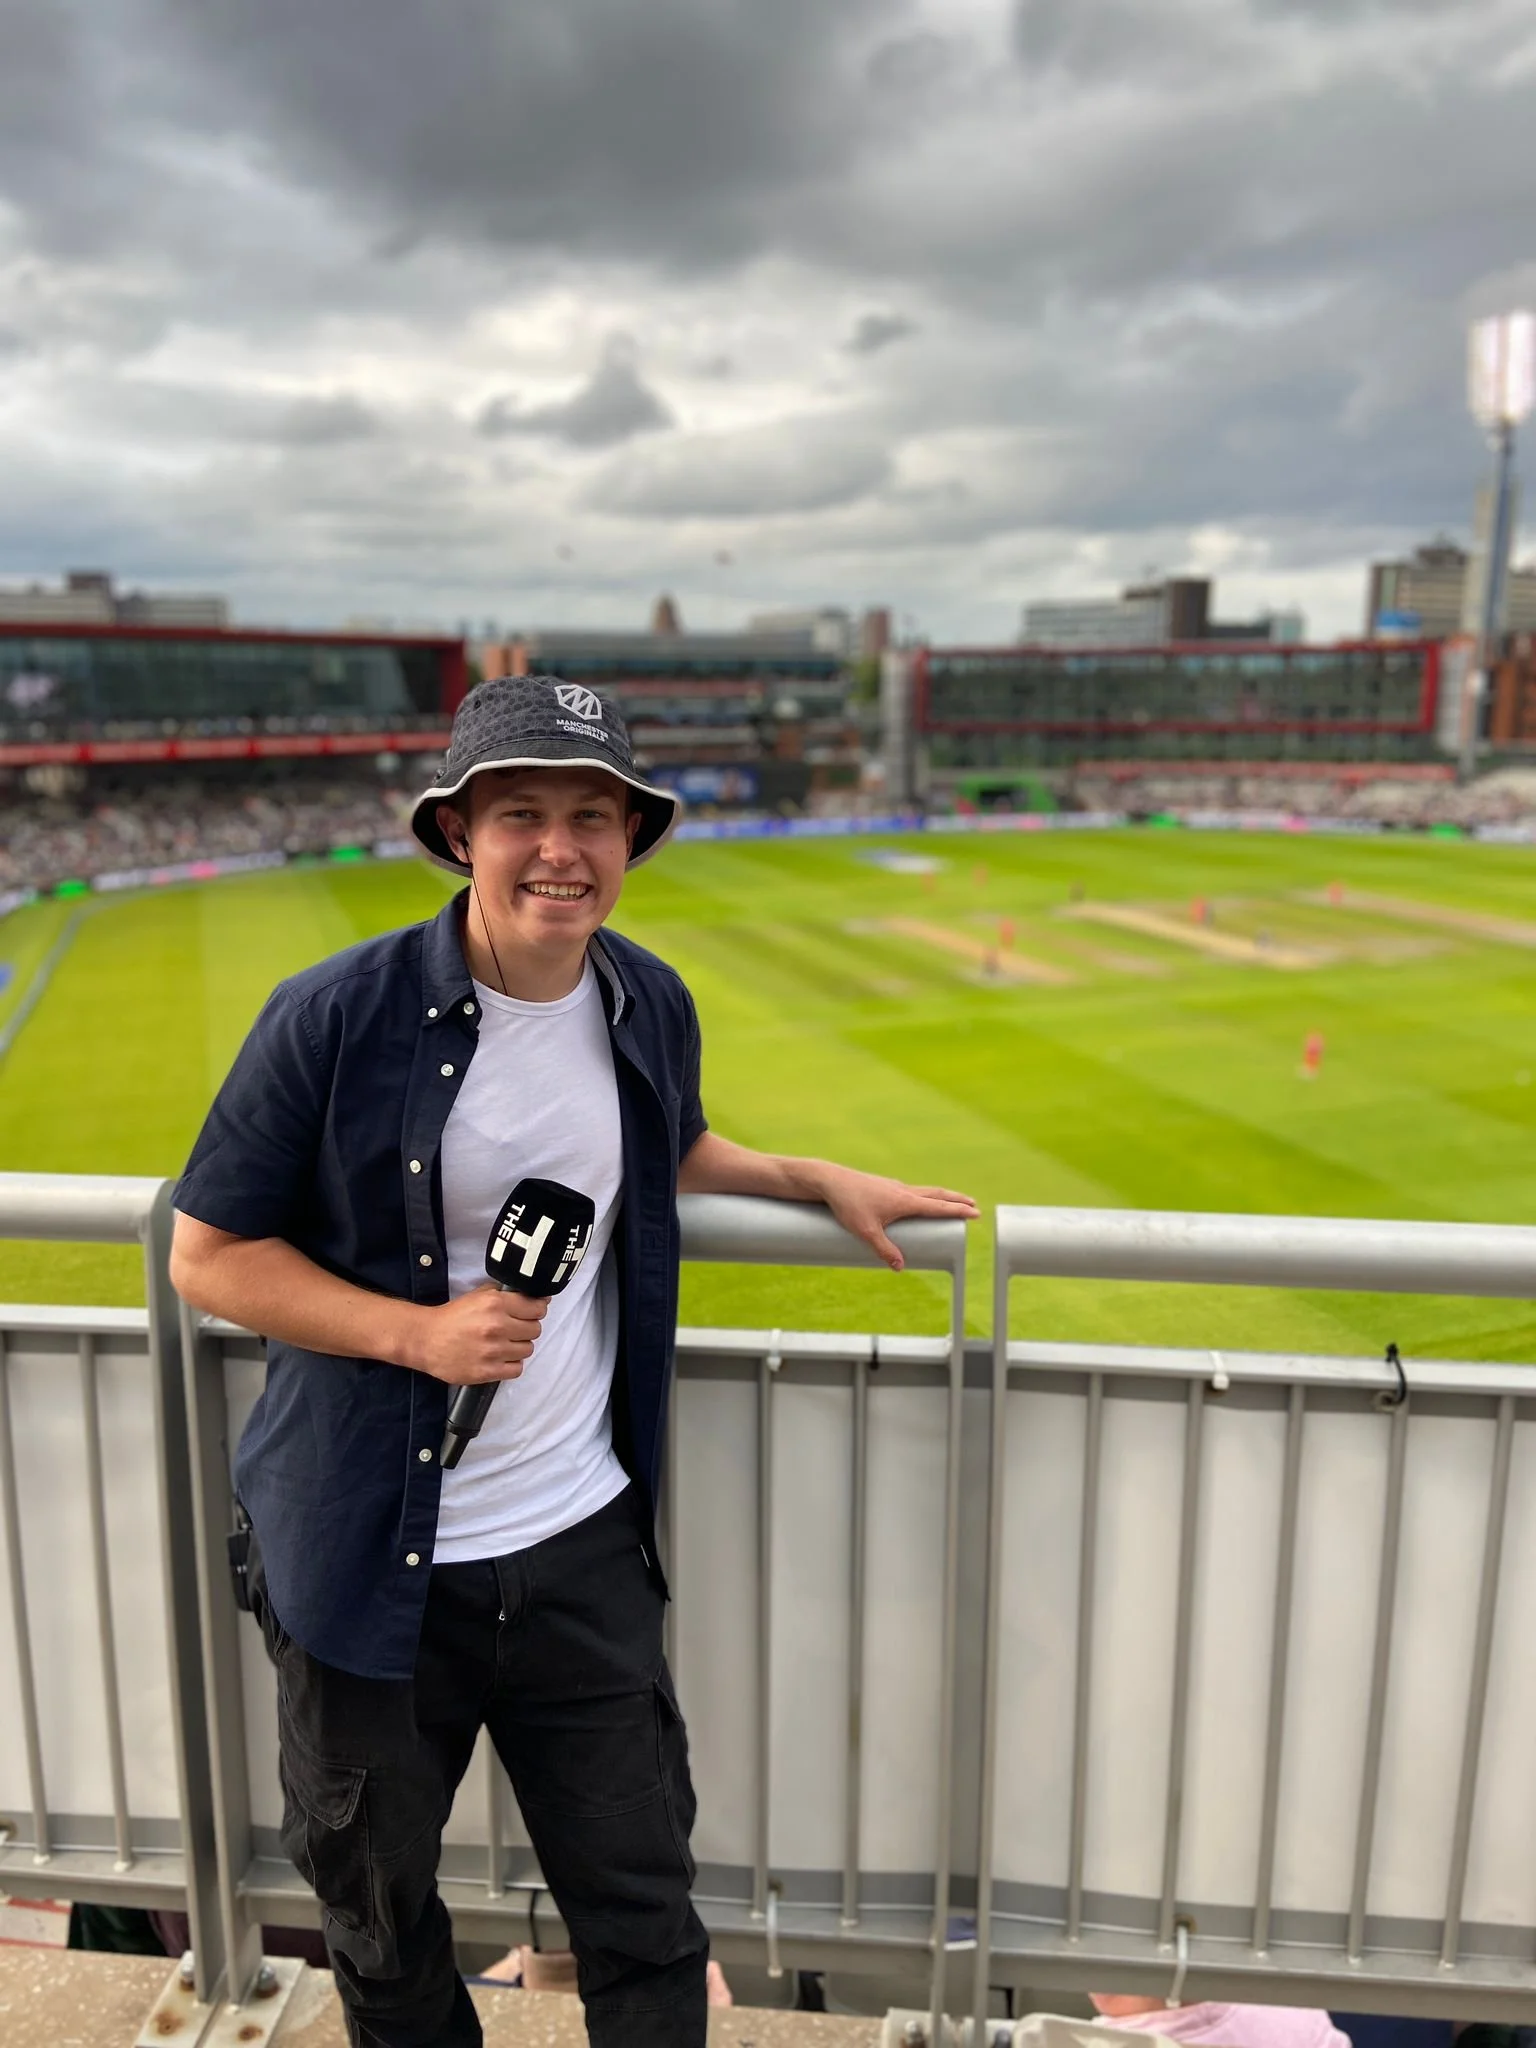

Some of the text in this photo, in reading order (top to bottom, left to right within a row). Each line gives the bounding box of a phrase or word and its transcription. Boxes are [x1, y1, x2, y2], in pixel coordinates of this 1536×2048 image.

[556, 719, 609, 740] MANCHESTER
[563, 725, 606, 742] ORIGINALS
[498, 1204, 526, 1241] THE
[561, 1224, 580, 1262] THE
